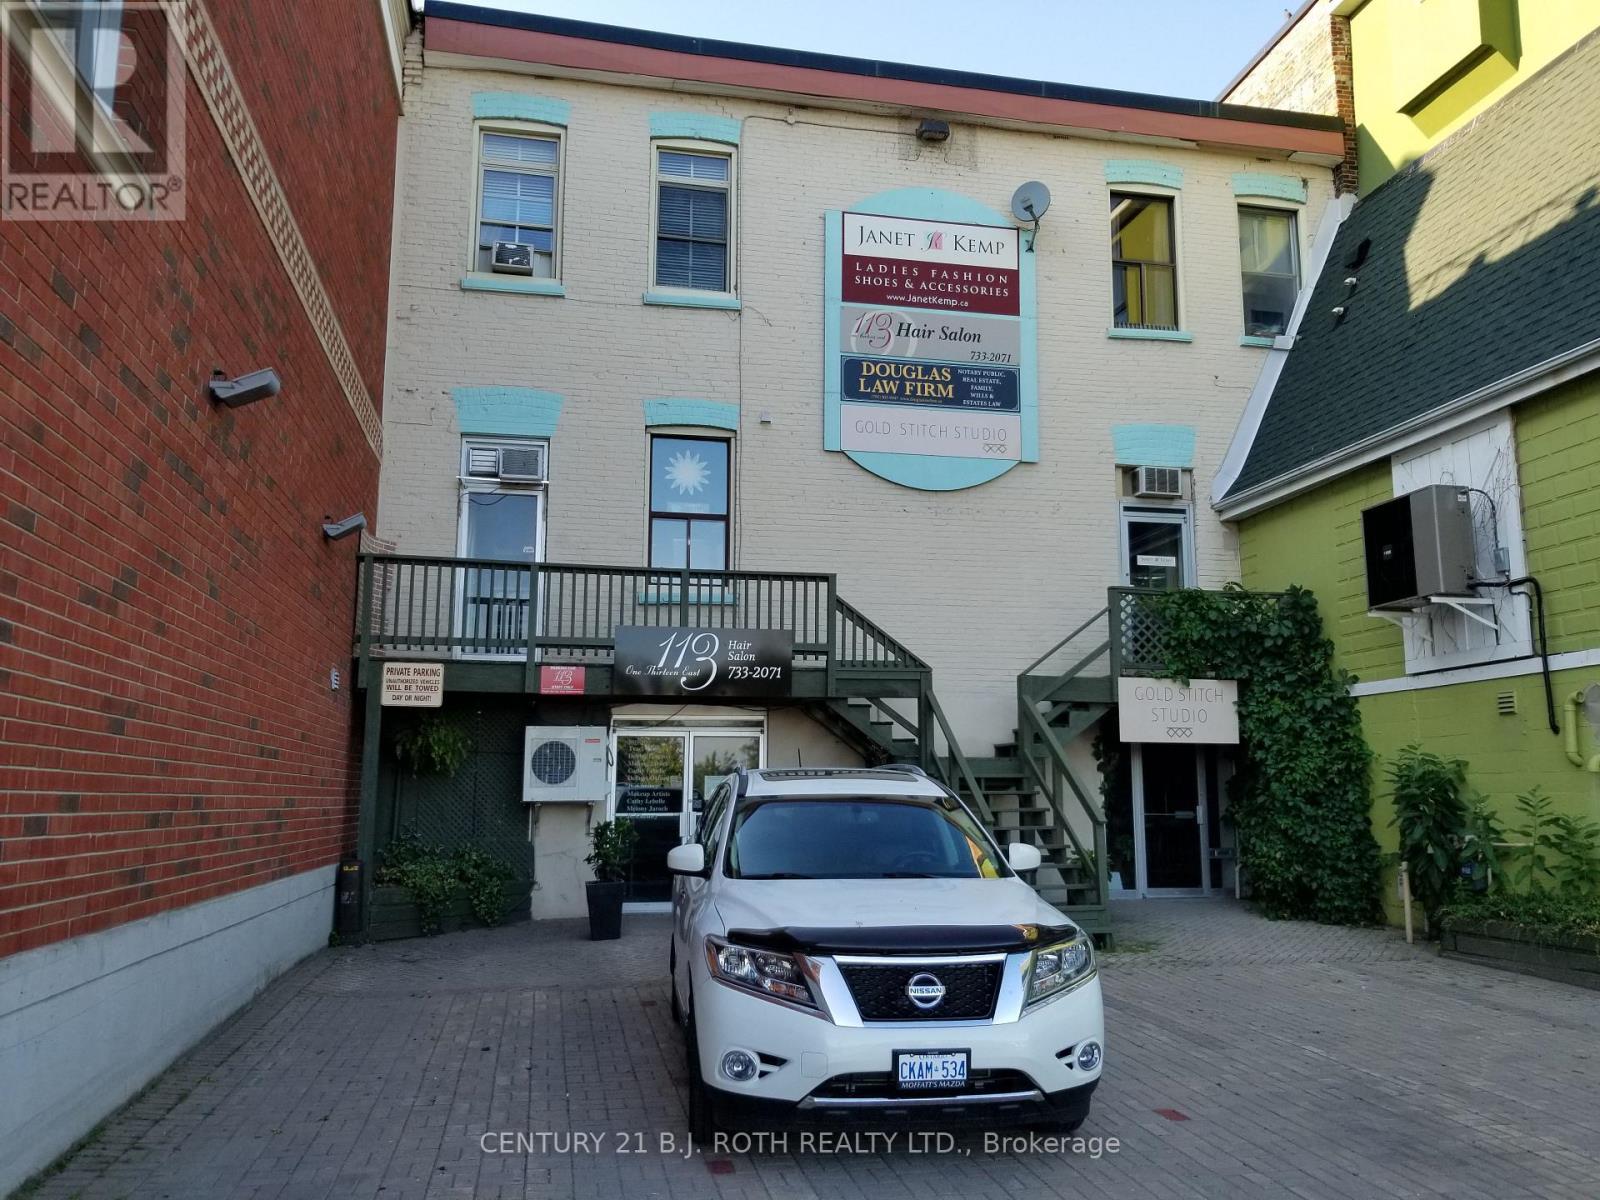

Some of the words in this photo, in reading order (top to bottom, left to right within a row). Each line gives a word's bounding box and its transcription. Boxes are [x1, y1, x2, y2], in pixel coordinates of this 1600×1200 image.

[858, 225, 915, 247] JANET
[953, 234, 1005, 255] KEMP
[856, 262, 919, 276] LADIES
[931, 269, 1008, 284] FASHION
[855, 275, 898, 288] SHOES
[904, 279, 914, 289] &
[920, 282, 1009, 297] ACCESSORIES
[886, 294, 969, 307] www.JanetKemp.ca
[855, 312, 892, 348] 113
[896, 322, 935, 340] Hair
[939, 325, 981, 343] Salon
[970, 351, 1012, 363] 733-2071
[862, 361, 952, 382] DOUGLAS
[858, 378, 899, 394] LAW
[904, 381, 954, 398] FIRM
[855, 419, 891, 435] GOLD
[899, 422, 948, 439] STITCH
[954, 425, 1007, 442] STUDIO
[727, 640, 751, 650] Hair
[659, 631, 720, 691] 113
[727, 651, 756, 661] Salon
[386, 667, 411, 676] PRIVATE
[413, 667, 441, 677] PARKING
[728, 666, 782, 680] 733-2071
[1134, 686, 1173, 702] GOLD
[1178, 687, 1224, 703] STITCH
[1151, 707, 1208, 723] STUDIO
[938, 1080, 966, 1088] MAZDA
